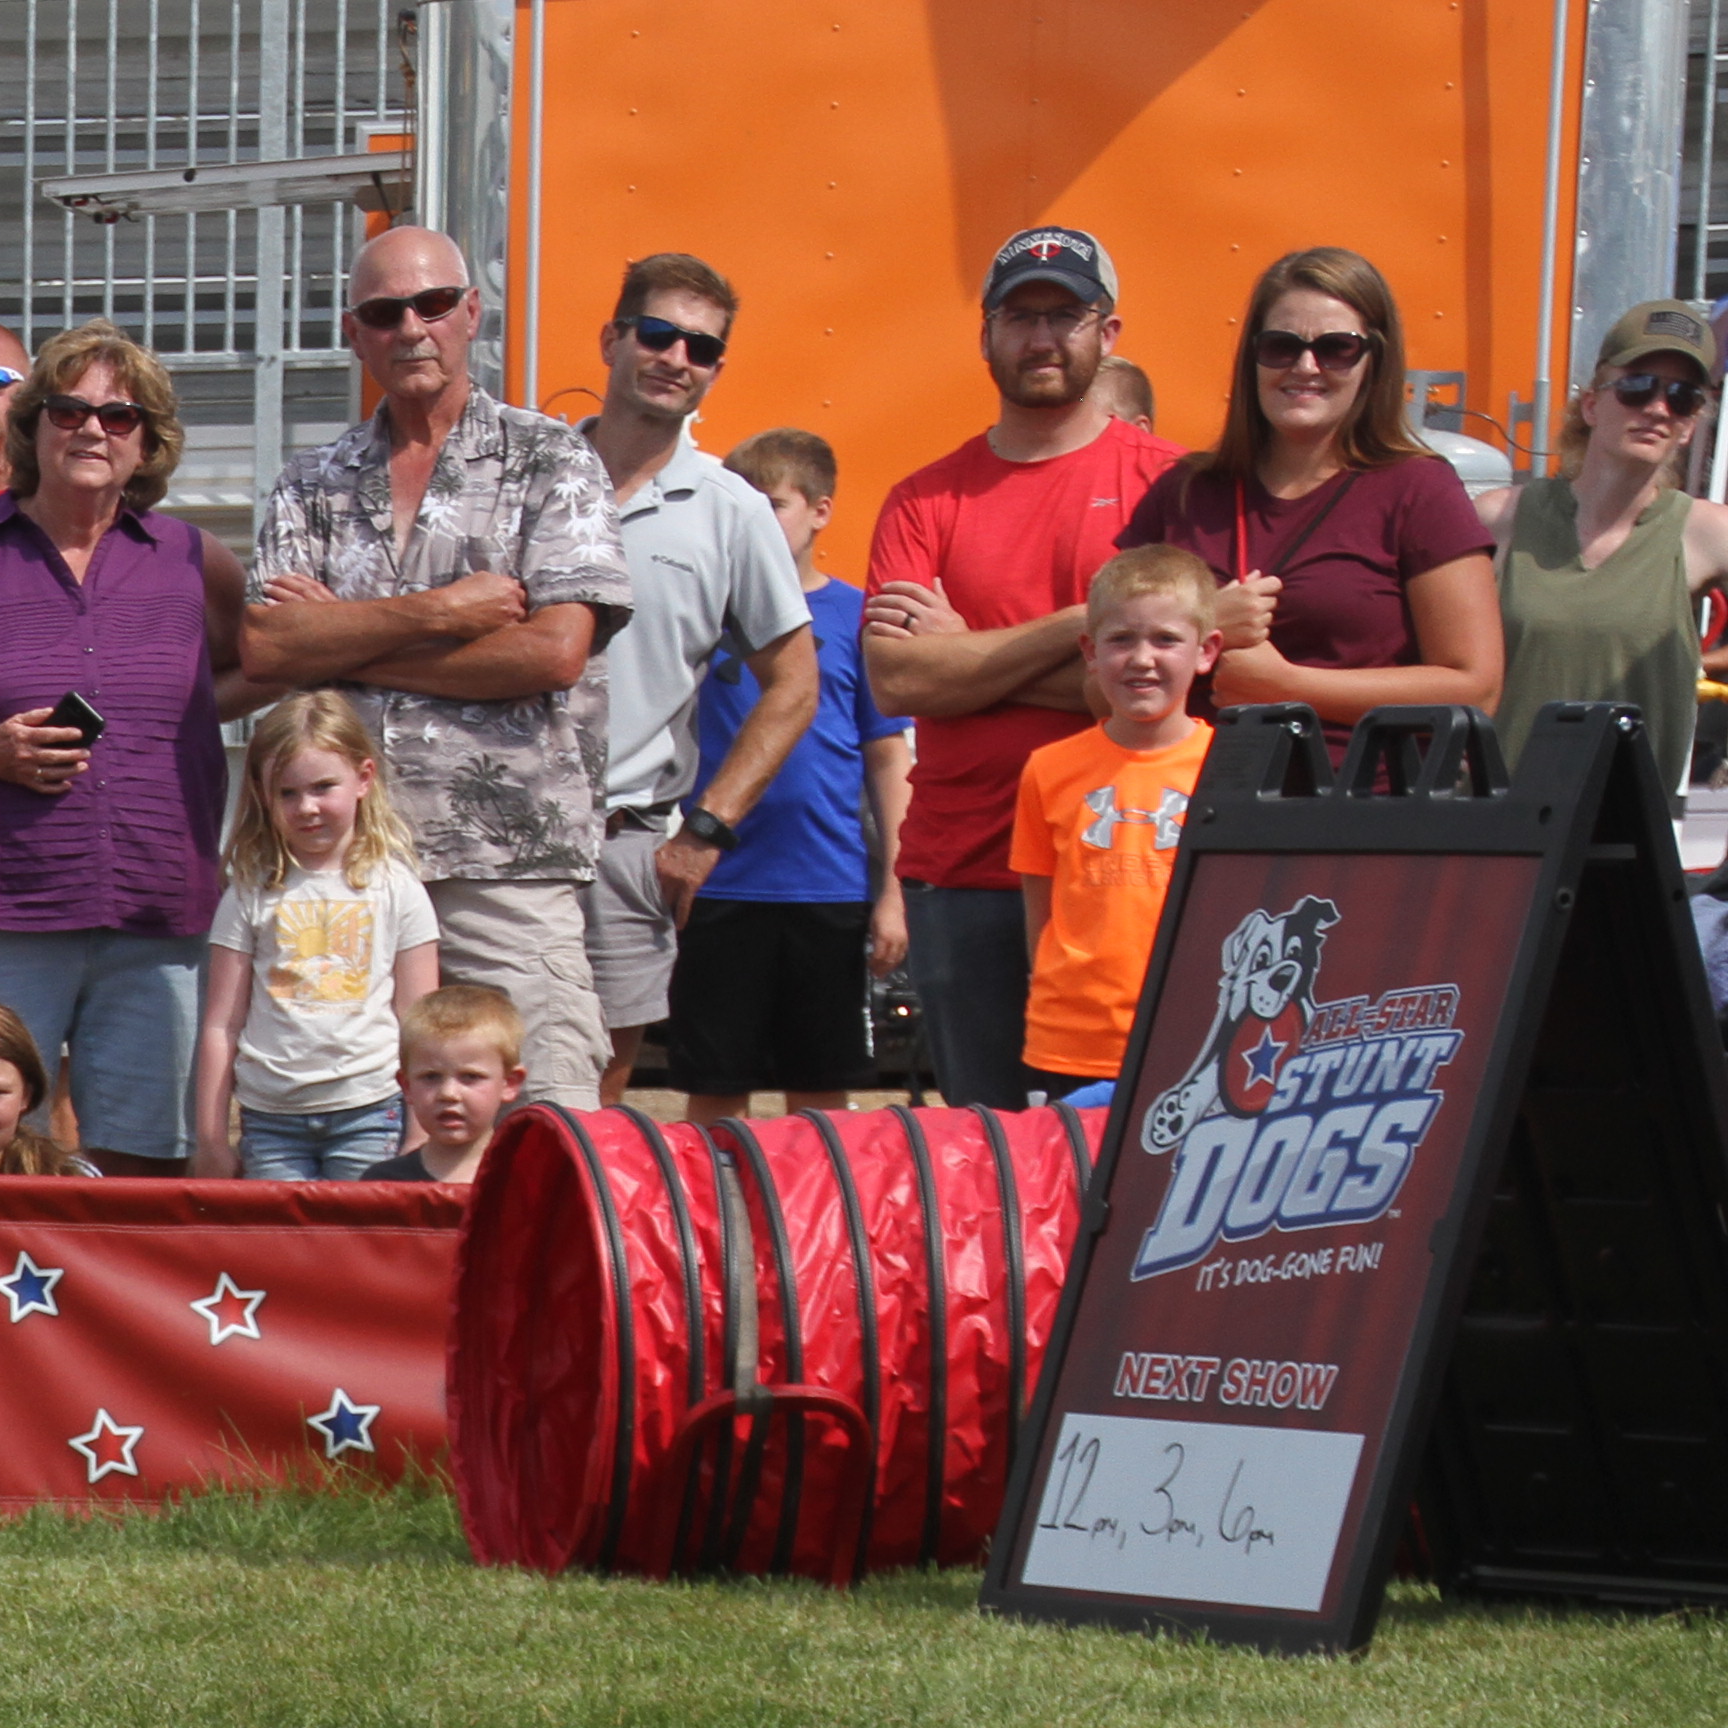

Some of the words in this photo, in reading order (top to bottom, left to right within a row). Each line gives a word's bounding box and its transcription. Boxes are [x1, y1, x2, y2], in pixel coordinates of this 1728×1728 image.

[996, 231, 1093, 266] MINNESOTA
[1301, 989, 1458, 1048] ALL-STAR
[1265, 1033, 1461, 1115] STUNT
[1138, 1097, 1437, 1267] DOGS
[1195, 1256, 1234, 1292] IT'S
[1234, 1247, 1335, 1286] DOG-GONE
[1335, 1242, 1384, 1275] FUN!
[1114, 1352, 1221, 1402] NEXT
[1221, 1357, 1340, 1411] SHOW
